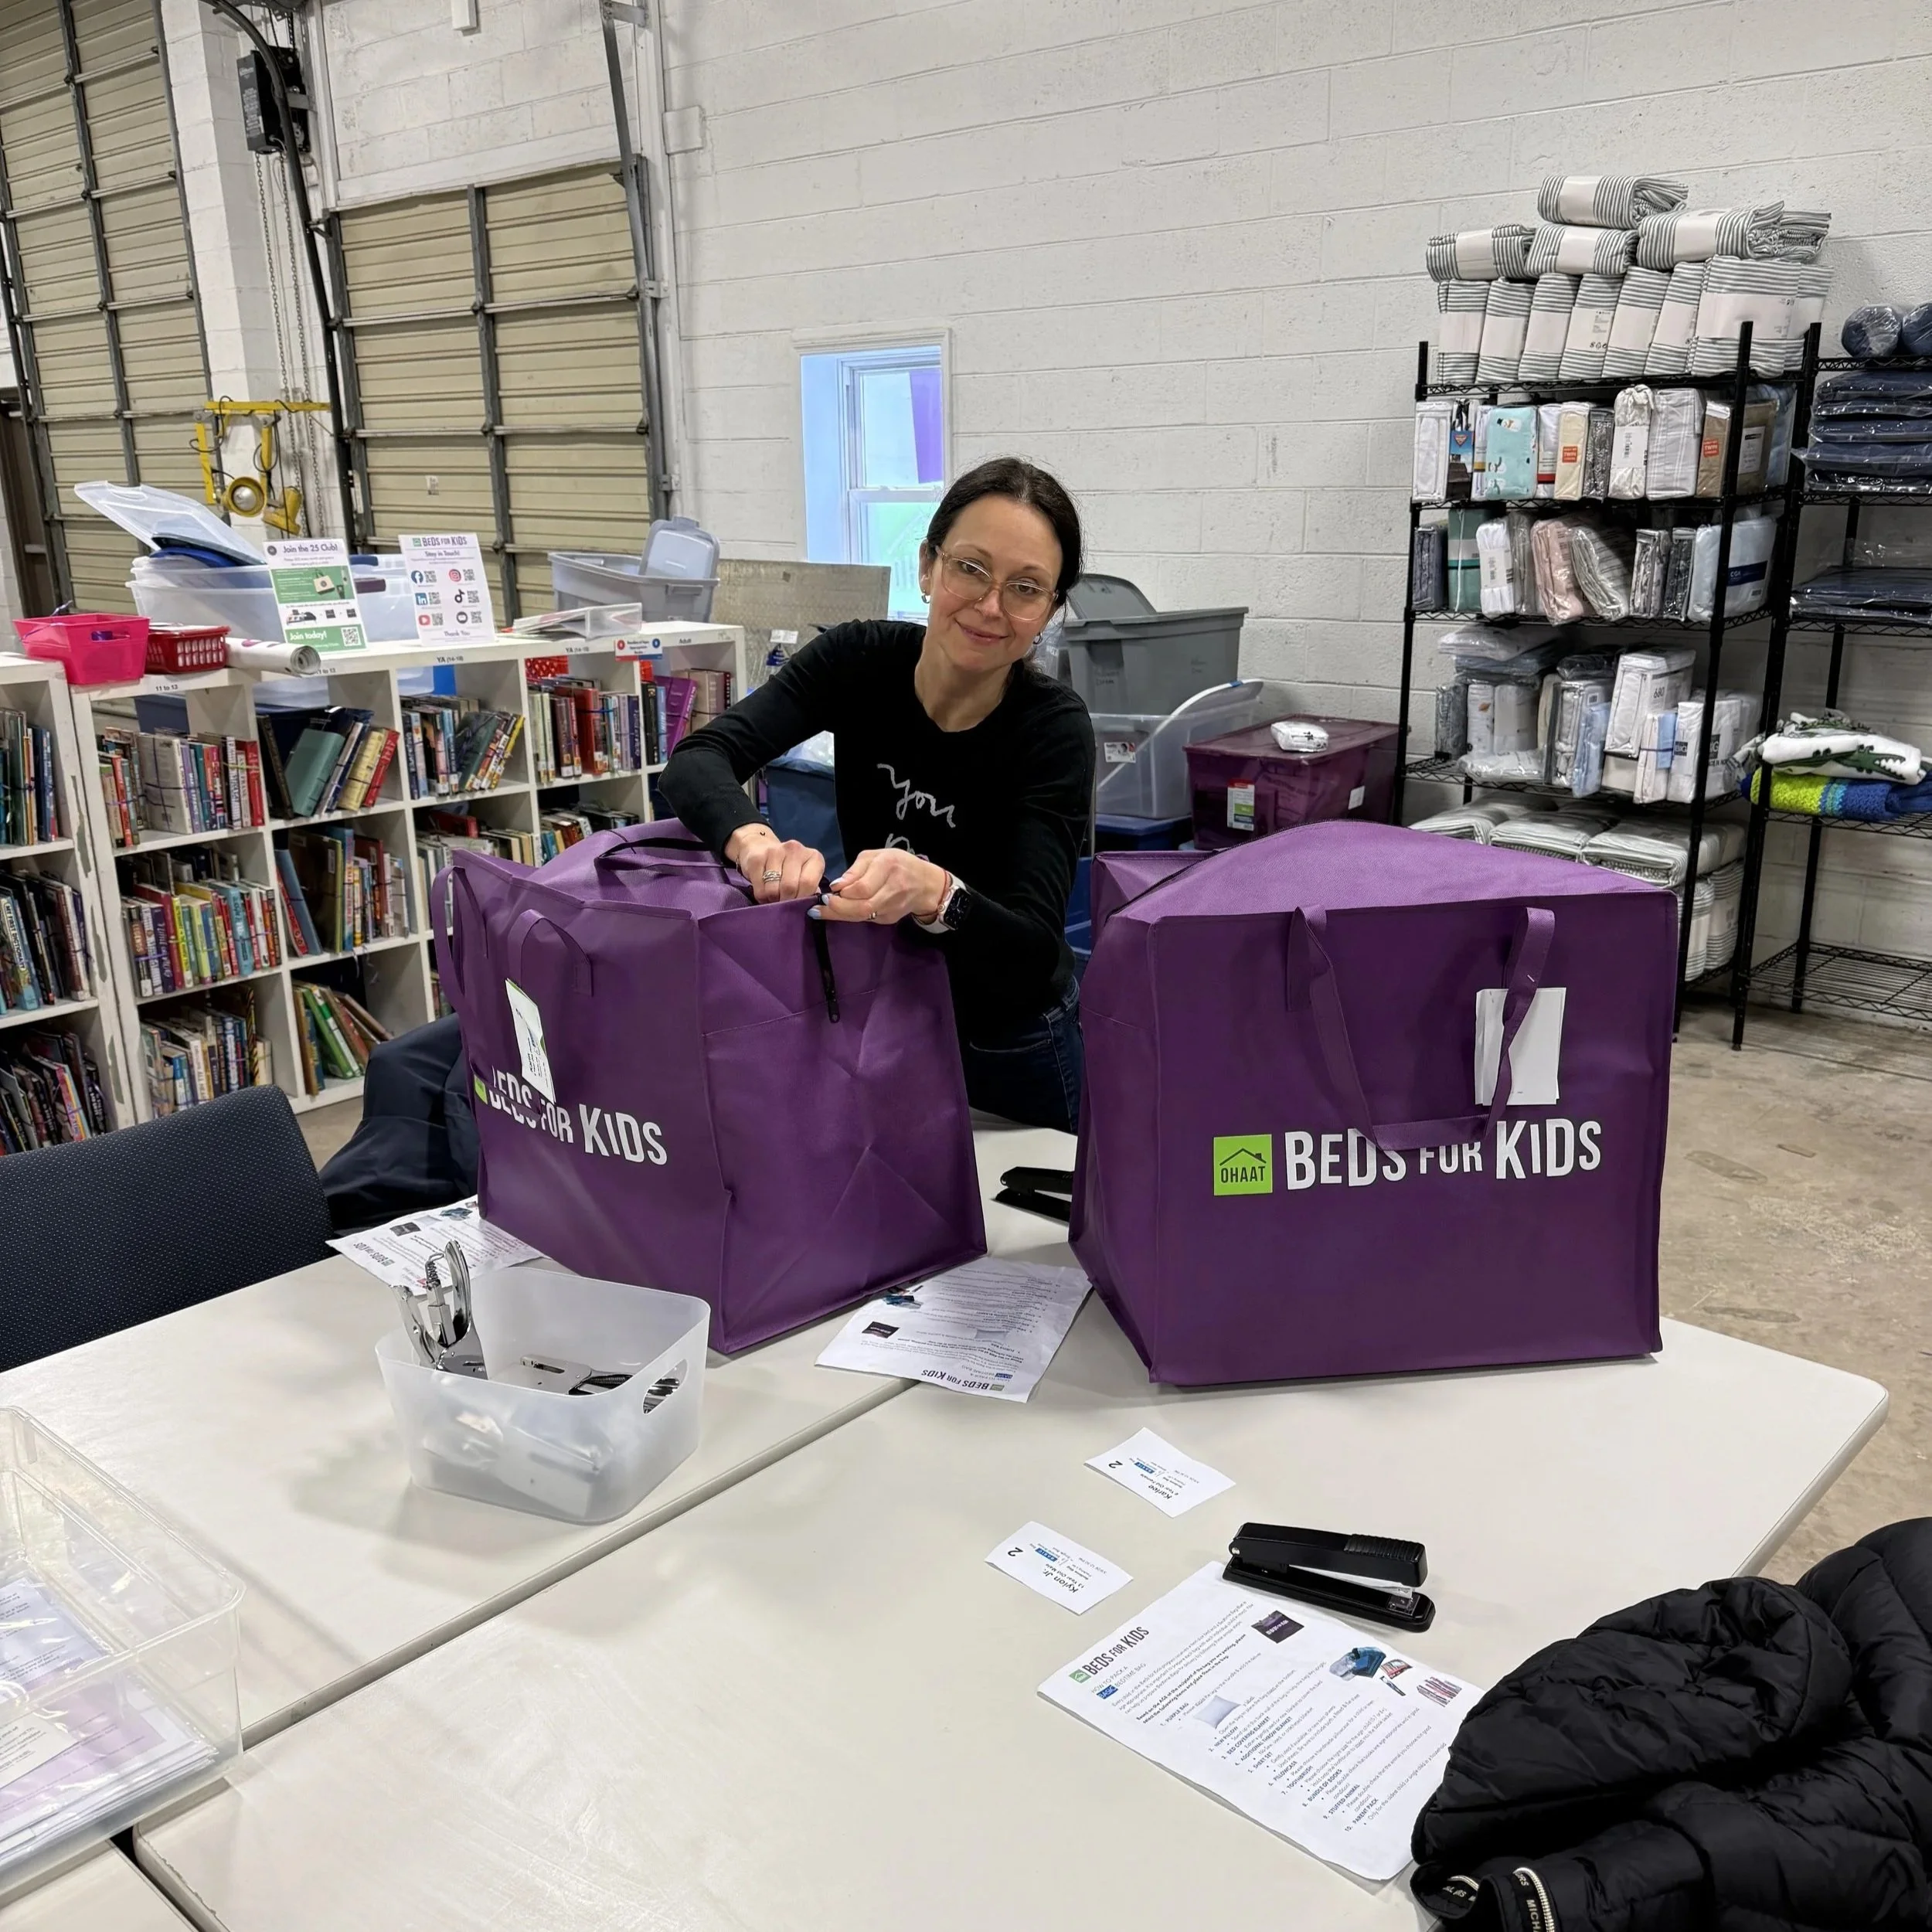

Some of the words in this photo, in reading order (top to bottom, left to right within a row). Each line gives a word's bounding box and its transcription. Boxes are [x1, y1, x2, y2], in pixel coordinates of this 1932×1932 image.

[321, 543, 338, 552] Club!
[422, 537, 440, 546] BEDS
[451, 536, 467, 546] KIDS
[290, 632, 304, 641] Join
[305, 631, 327, 641] today!
[876, 763, 957, 828] you
[7, 915, 16, 932] FIRST
[579, 1104, 668, 1165] KIDS
[1284, 1128, 1407, 1190] BEDS
[1419, 1142, 1483, 1175] FOR
[1495, 1118, 1601, 1180] KIDS
[1220, 1165, 1266, 1185] OHAAT
[920, 1369, 946, 1379] KIDS
[946, 1374, 961, 1384] FOR
[961, 1379, 989, 1389] BEDS
[1107, 1460, 1123, 1468] 2
[1148, 1485, 1172, 1499] Karlee
[1007, 1546, 1023, 1556] 2
[1043, 1568, 1053, 1577] Jr.
[1045, 1563, 1056, 1572] Male
[1053, 1576, 1078, 1593] Kylon
[1066, 1576, 1077, 1584] Year
[1082, 1652, 1114, 1675] BEDS
[1108, 1643, 1127, 1657] FOR
[1120, 1626, 1149, 1648] KIDS
[1090, 1683, 1104, 1693] HOW
[1109, 1668, 1123, 1679] PACK
[1097, 1685, 1117, 1699] BASIC
[1114, 1669, 1135, 1687] BEDTIME
[1133, 1662, 1146, 1672] BAG
[1165, 1709, 1180, 1722] PURPLE
[1213, 1738, 1224, 1747] NEW
[1222, 1726, 1238, 1740] PILLOW
[1226, 1746, 1236, 1754] BED
[1234, 1730, 1255, 1747] COVERING
[1253, 1716, 1269, 1731] BLANKET
[1240, 1741, 1264, 1761] ADDITIONAL
[1261, 1730, 1277, 1742] THROW
[1274, 1716, 1291, 1731] BLANKET
[1252, 1757, 1265, 1768] SHEET
[1273, 1760, 1297, 1781] PILLOWCASE
[1286, 1765, 1312, 1788] TOOTHBRUSH
[1307, 1785, 1324, 1801] BUNDLE
[1327, 1768, 1342, 1782] BOOKS
[1328, 1798, 1345, 1815] STUFFED
[1344, 1784, 1360, 1798] ANIMAL
[1352, 1808, 1367, 1824] PARENT
[1366, 1798, 1378, 1809] PACK
[1526, 1899, 1542, 1932] MICH
